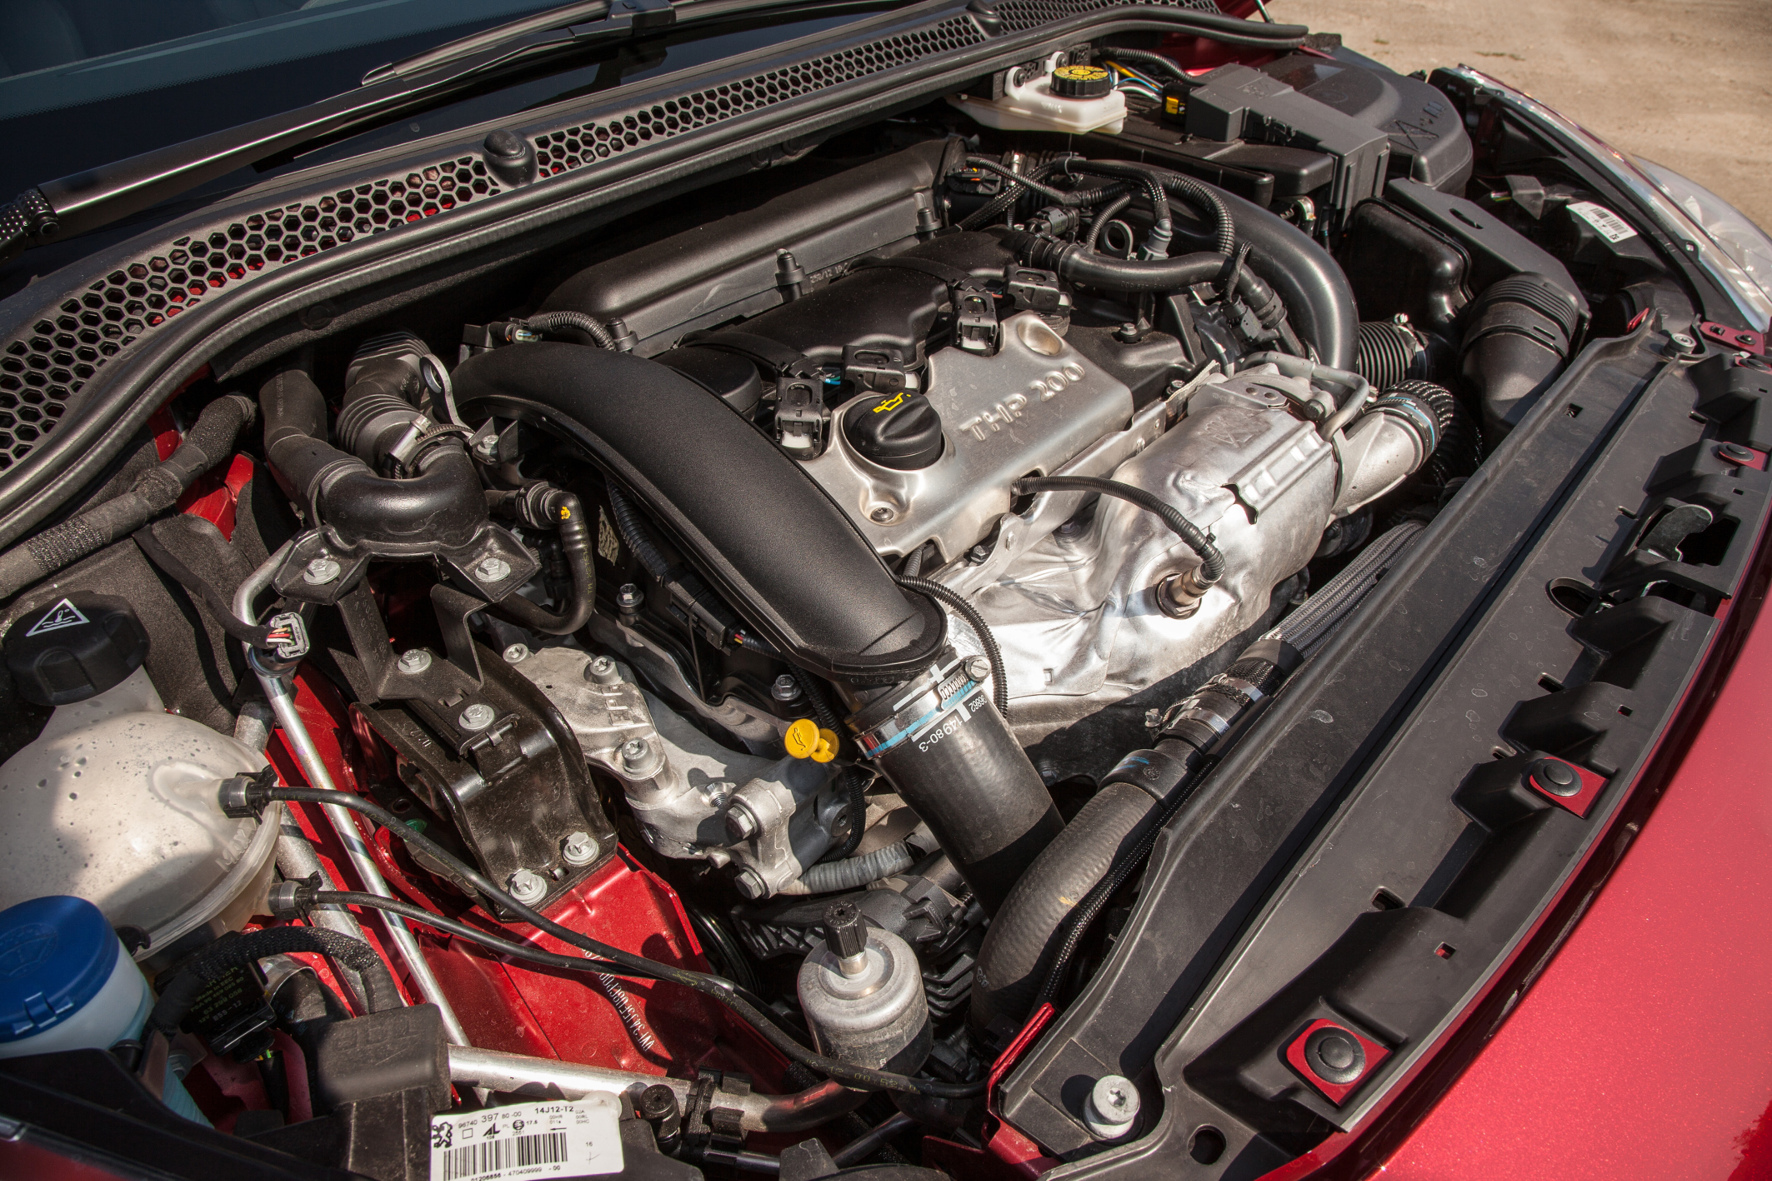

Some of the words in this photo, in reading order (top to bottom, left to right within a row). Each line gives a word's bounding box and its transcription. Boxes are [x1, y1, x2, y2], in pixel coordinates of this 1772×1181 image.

[959, 393, 1027, 441] THP
[1030, 362, 1086, 402] 200
[943, 715, 963, 736] 149
[919, 729, 944, 752] 80-3
[481, 1113, 499, 1123] 397
[535, 1106, 574, 1114] 14J12-T2
